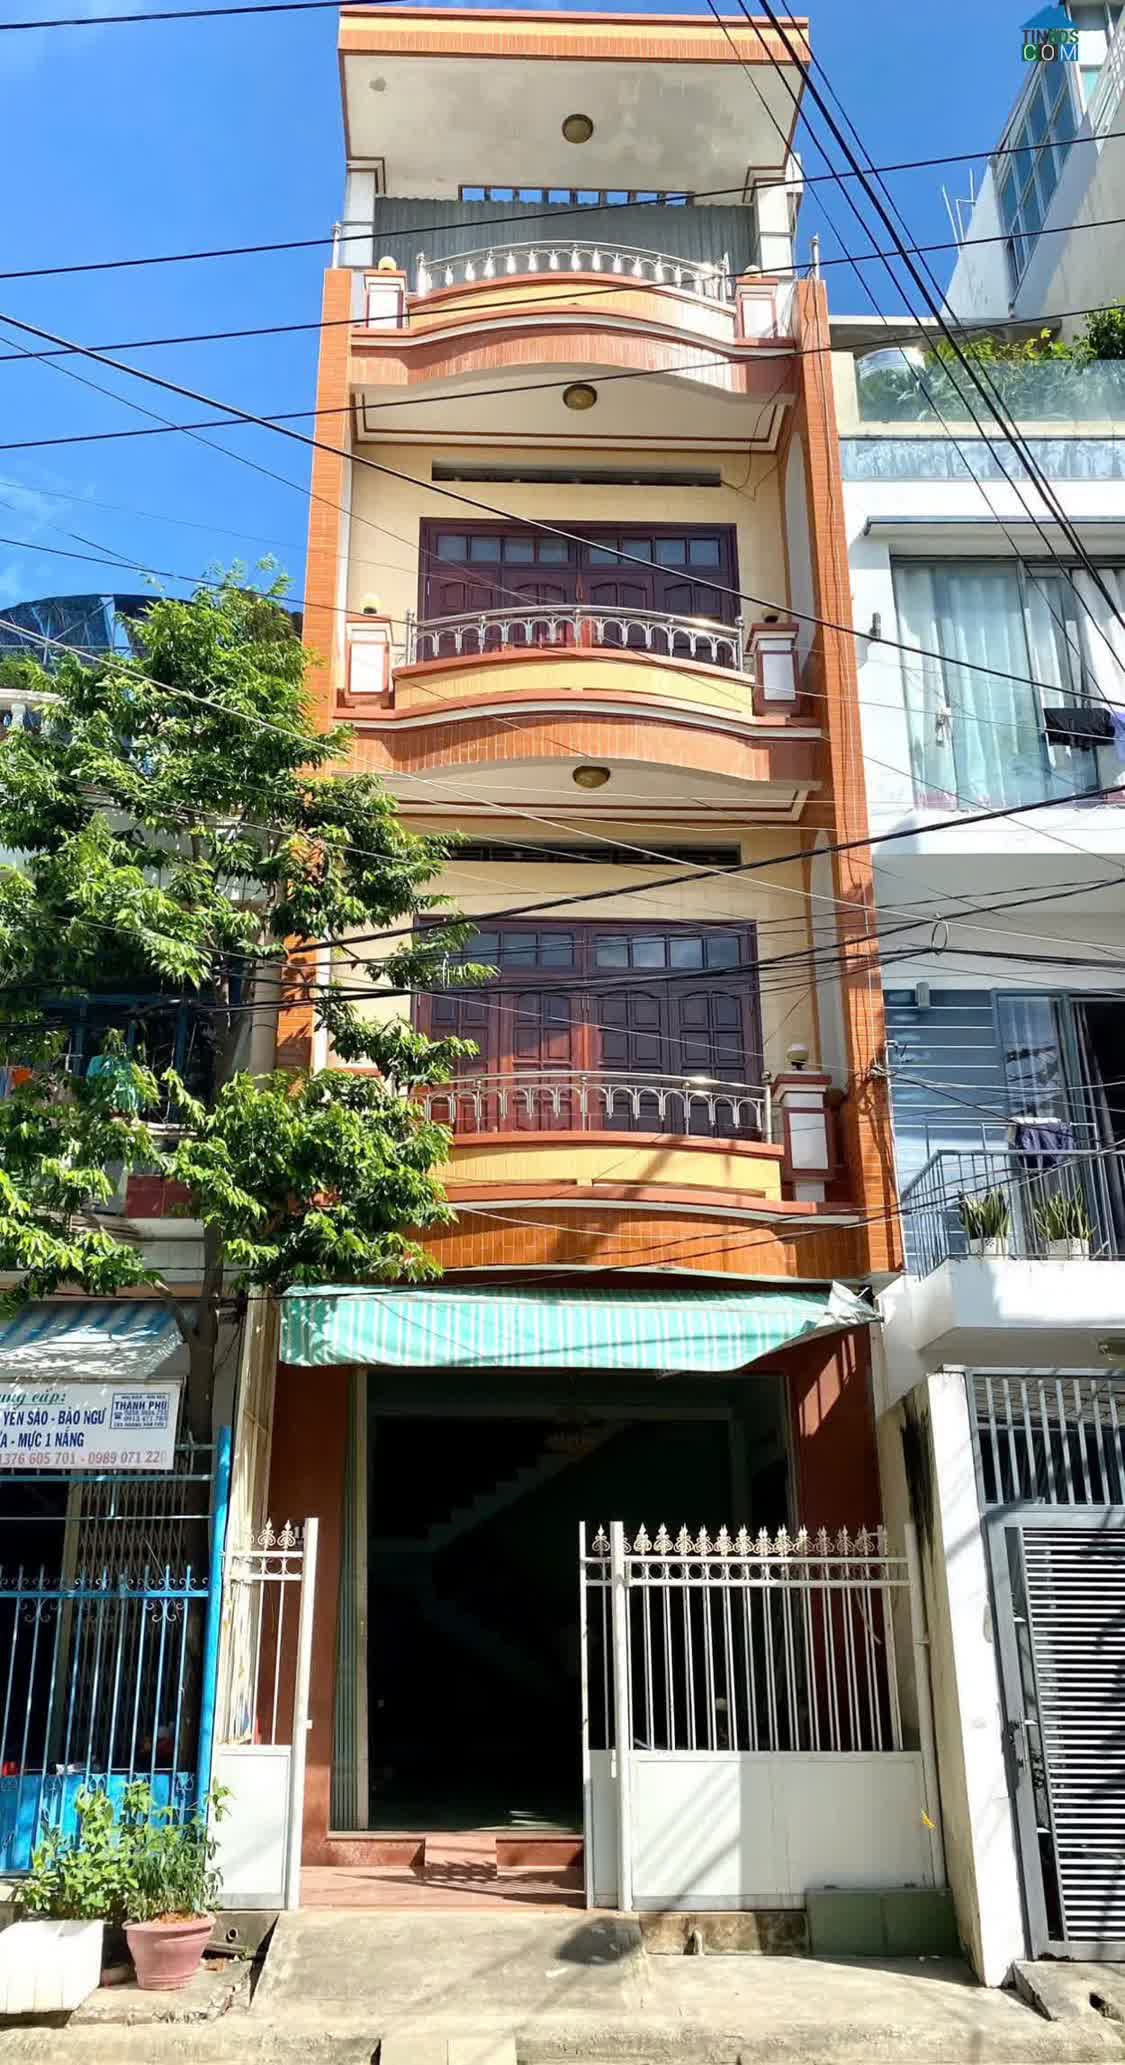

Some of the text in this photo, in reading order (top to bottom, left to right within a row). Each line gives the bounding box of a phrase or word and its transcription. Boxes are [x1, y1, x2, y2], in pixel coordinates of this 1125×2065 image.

[83, 1408, 107, 1424] NGƯ
[18, 1430, 42, 1450] MỰC
[45, 1433, 50, 1447] 1
[55, 1425, 84, 1447] NẮNG
[29, 1452, 50, 1464] 605
[54, 1452, 75, 1464] 701
[120, 1451, 141, 1464] 071
